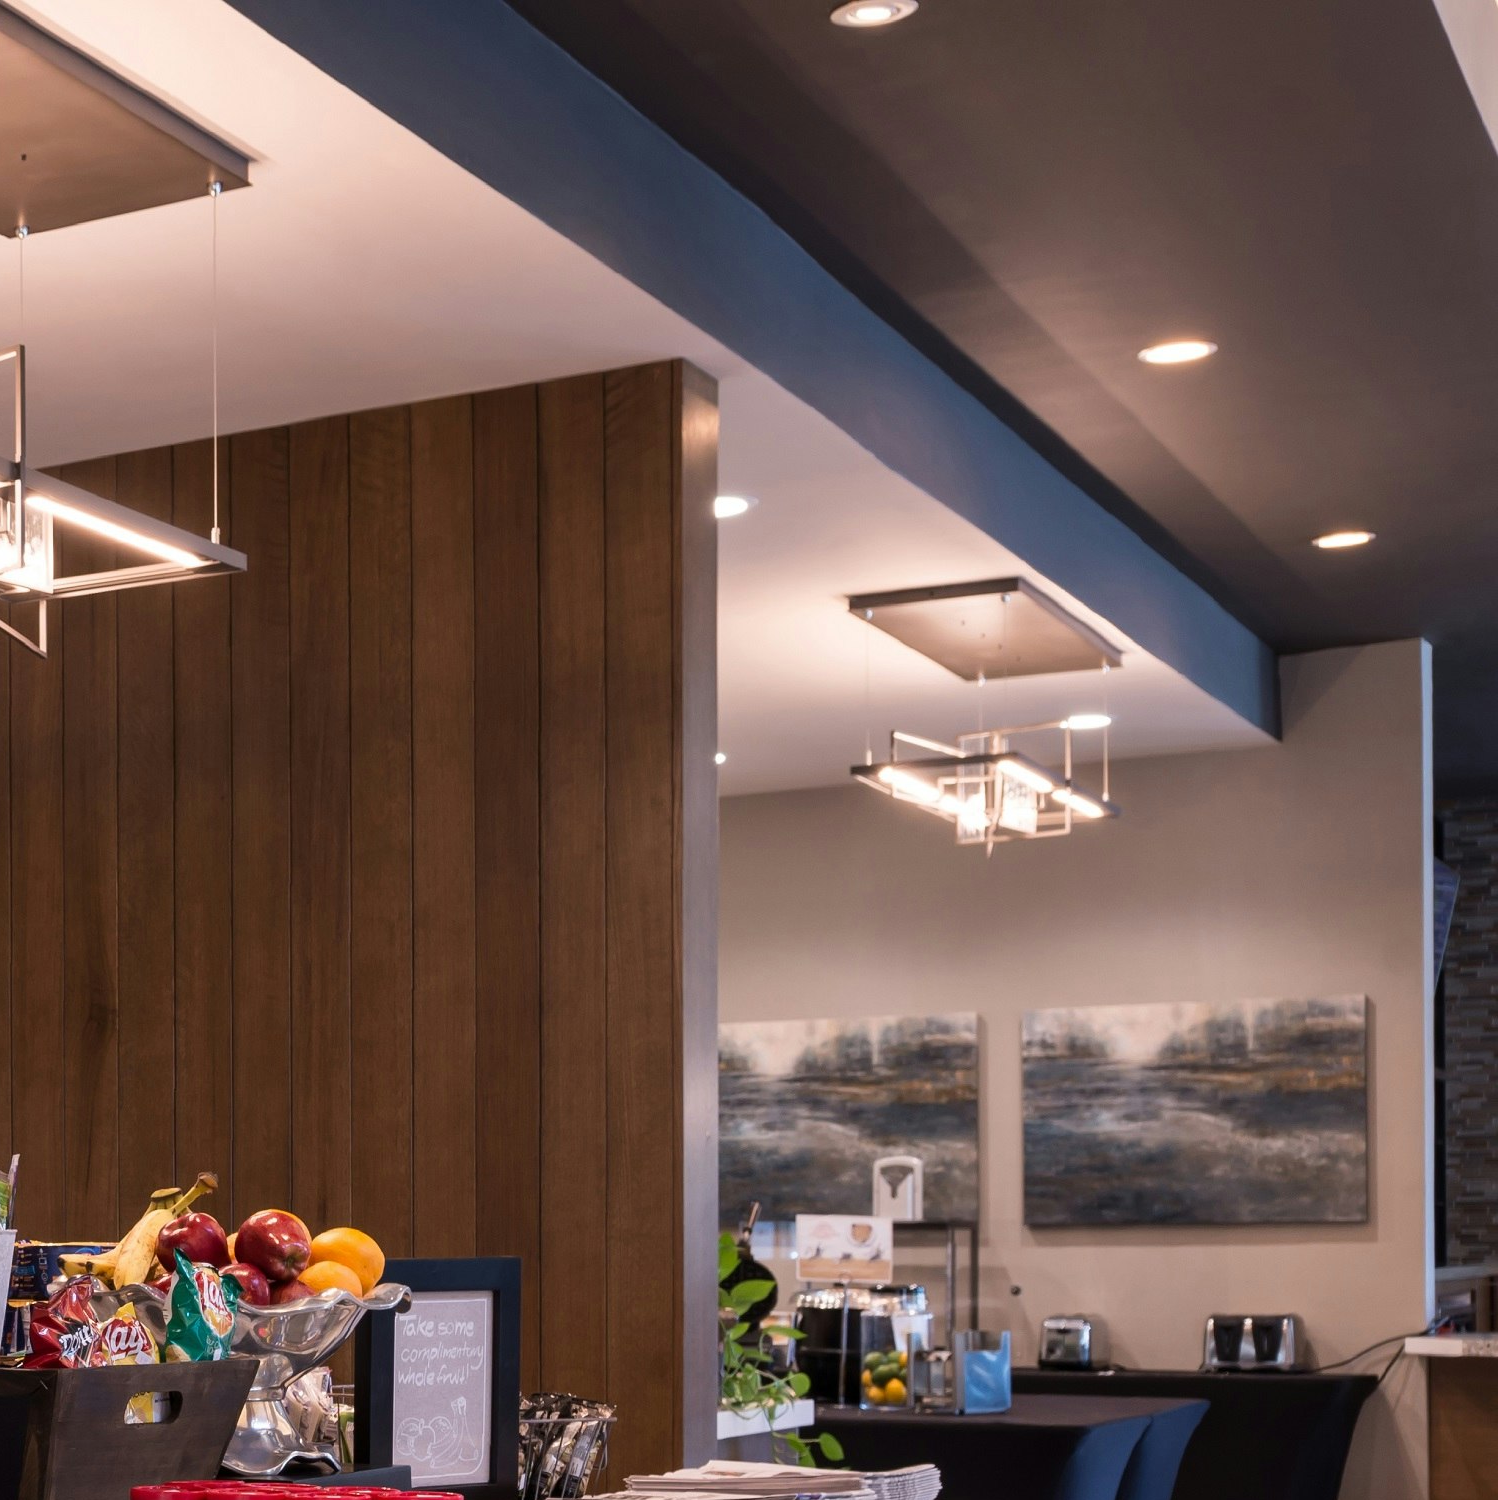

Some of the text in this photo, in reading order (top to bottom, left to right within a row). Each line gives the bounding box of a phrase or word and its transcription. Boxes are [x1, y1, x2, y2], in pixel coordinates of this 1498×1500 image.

[399, 1315, 475, 1338] Take some
[400, 1342, 484, 1371] complimentary
[397, 1368, 434, 1386] whole
